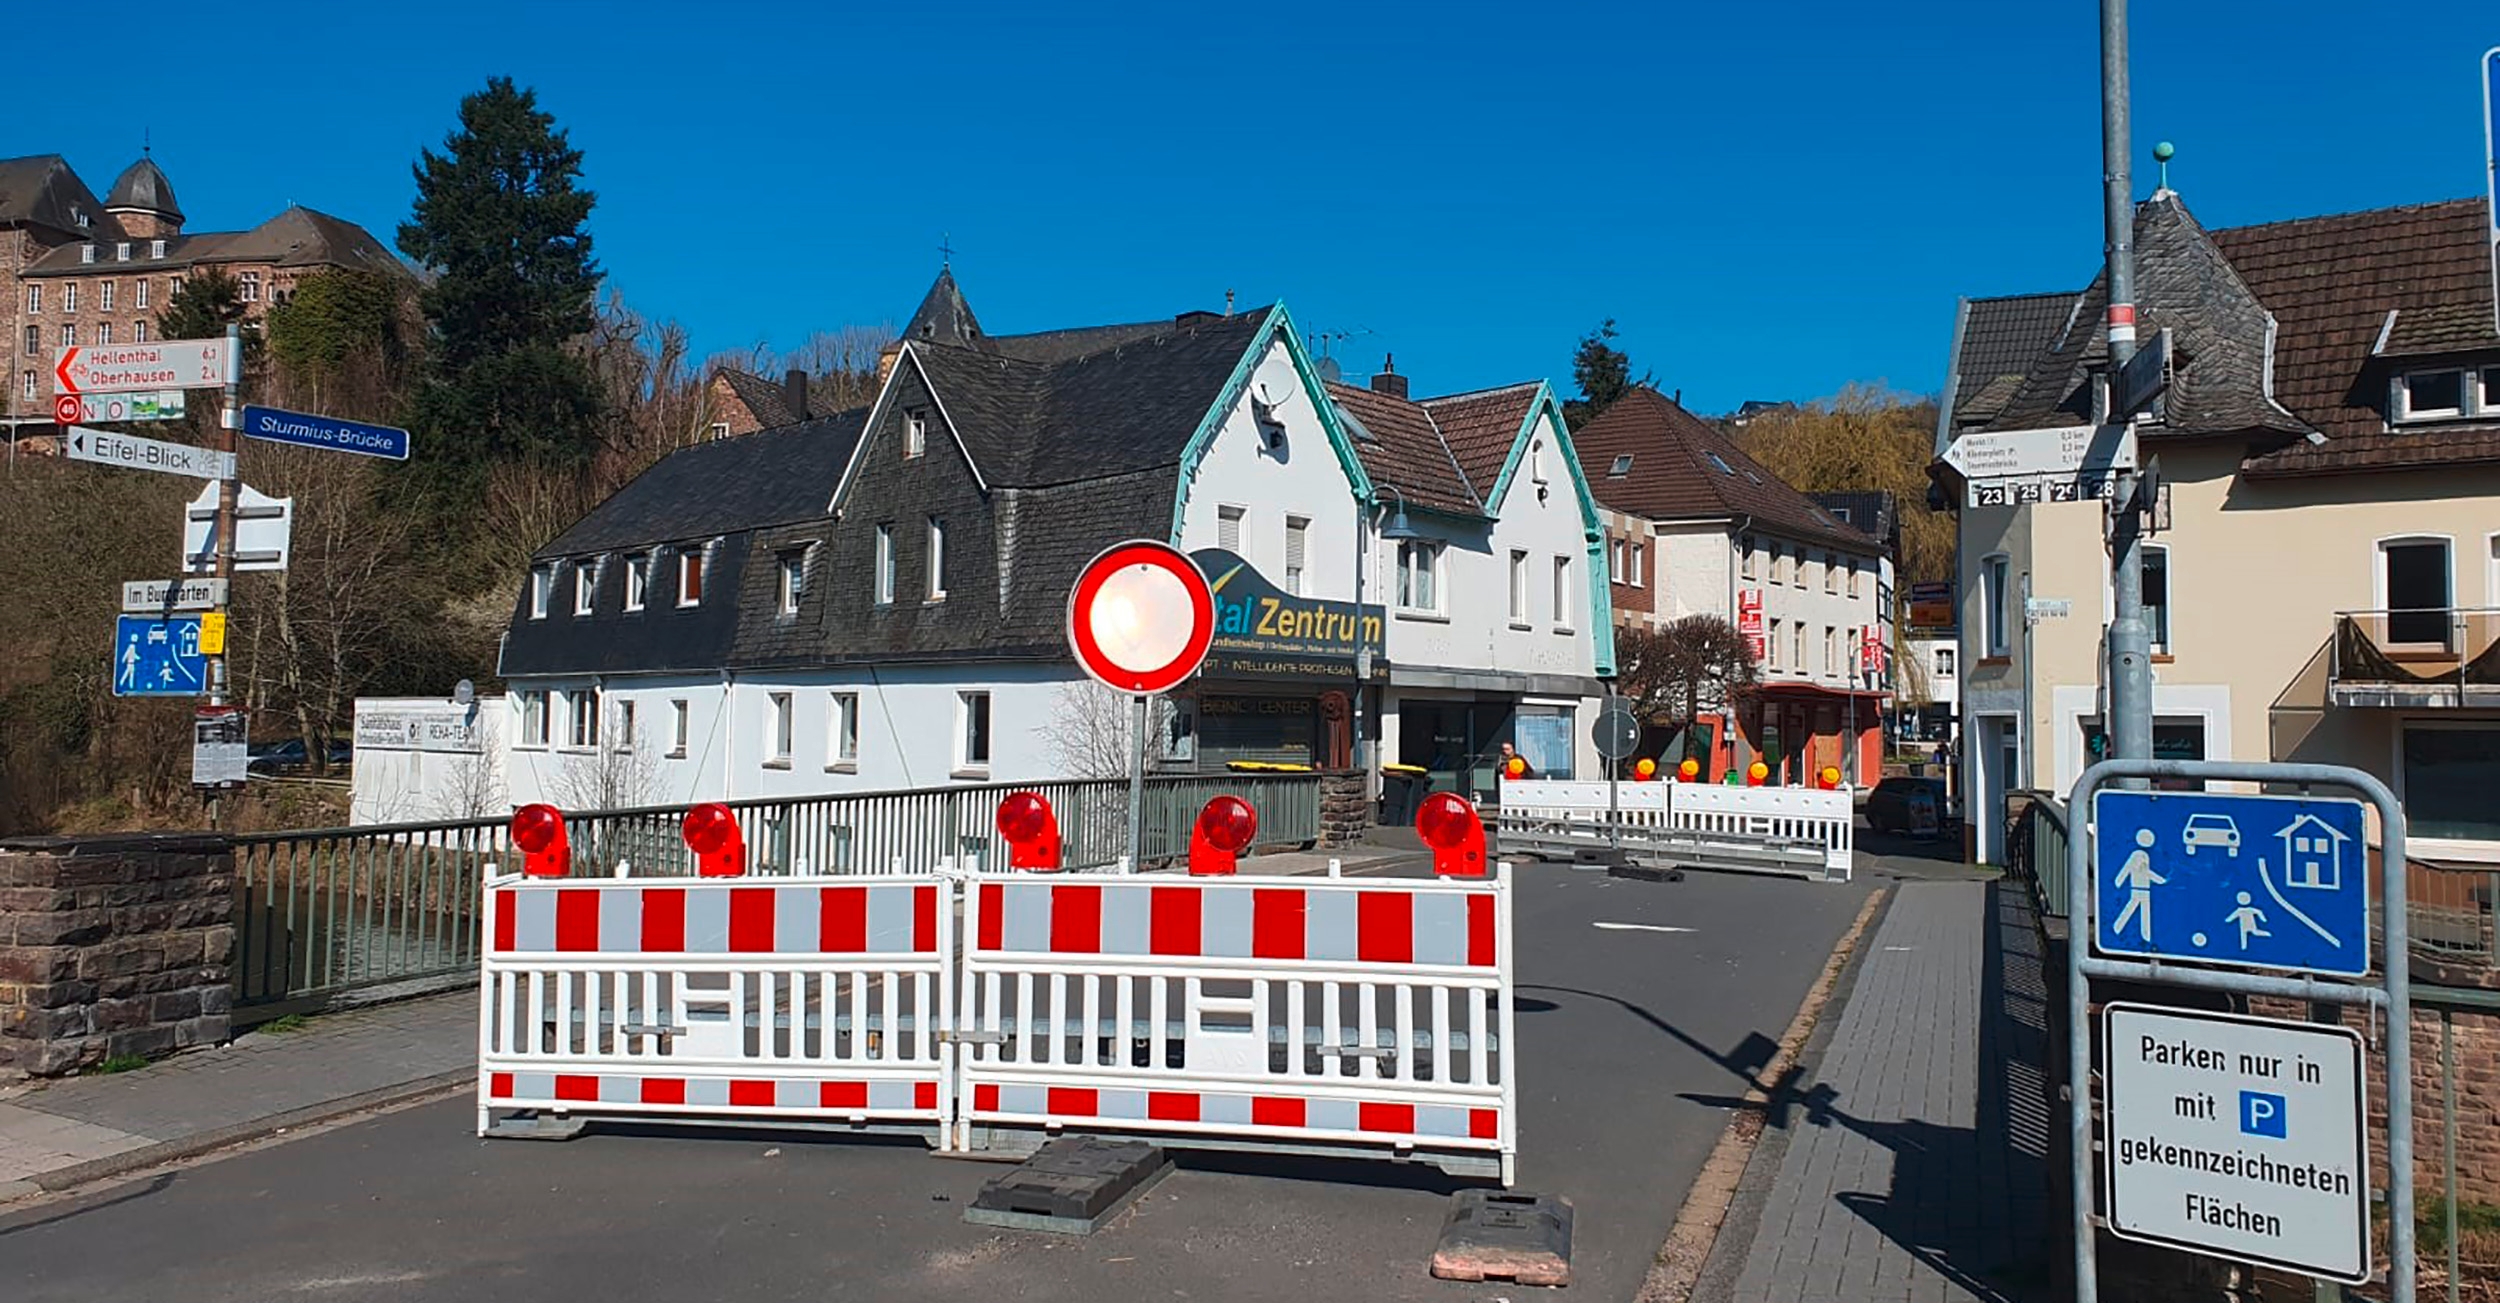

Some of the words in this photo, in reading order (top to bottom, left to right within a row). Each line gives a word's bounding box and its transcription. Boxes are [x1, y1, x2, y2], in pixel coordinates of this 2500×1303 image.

[91, 349, 161, 364] Hellenthal
[91, 369, 175, 385] Oberhausen
[259, 416, 394, 450] Sturmius-Brücke
[95, 437, 191, 469] Eifel-Blick
[1982, 489, 2003, 504] 23
[2021, 485, 2039, 499] 25
[2055, 484, 2076, 501] 29
[2093, 481, 2115, 497] 28
[128, 587, 142, 603] Im
[147, 585, 209, 607] Burggarten
[1256, 597, 1382, 644] Zentrum
[2141, 1035, 2226, 1071] Parken
[2239, 1053, 2282, 1078] nur
[2298, 1054, 2320, 1084] in
[2175, 1092, 2216, 1121] mit
[2251, 1098, 2275, 1129] P
[2120, 1136, 2350, 1195] gekennzeichneten
[2186, 1194, 2281, 1237] Flächen
